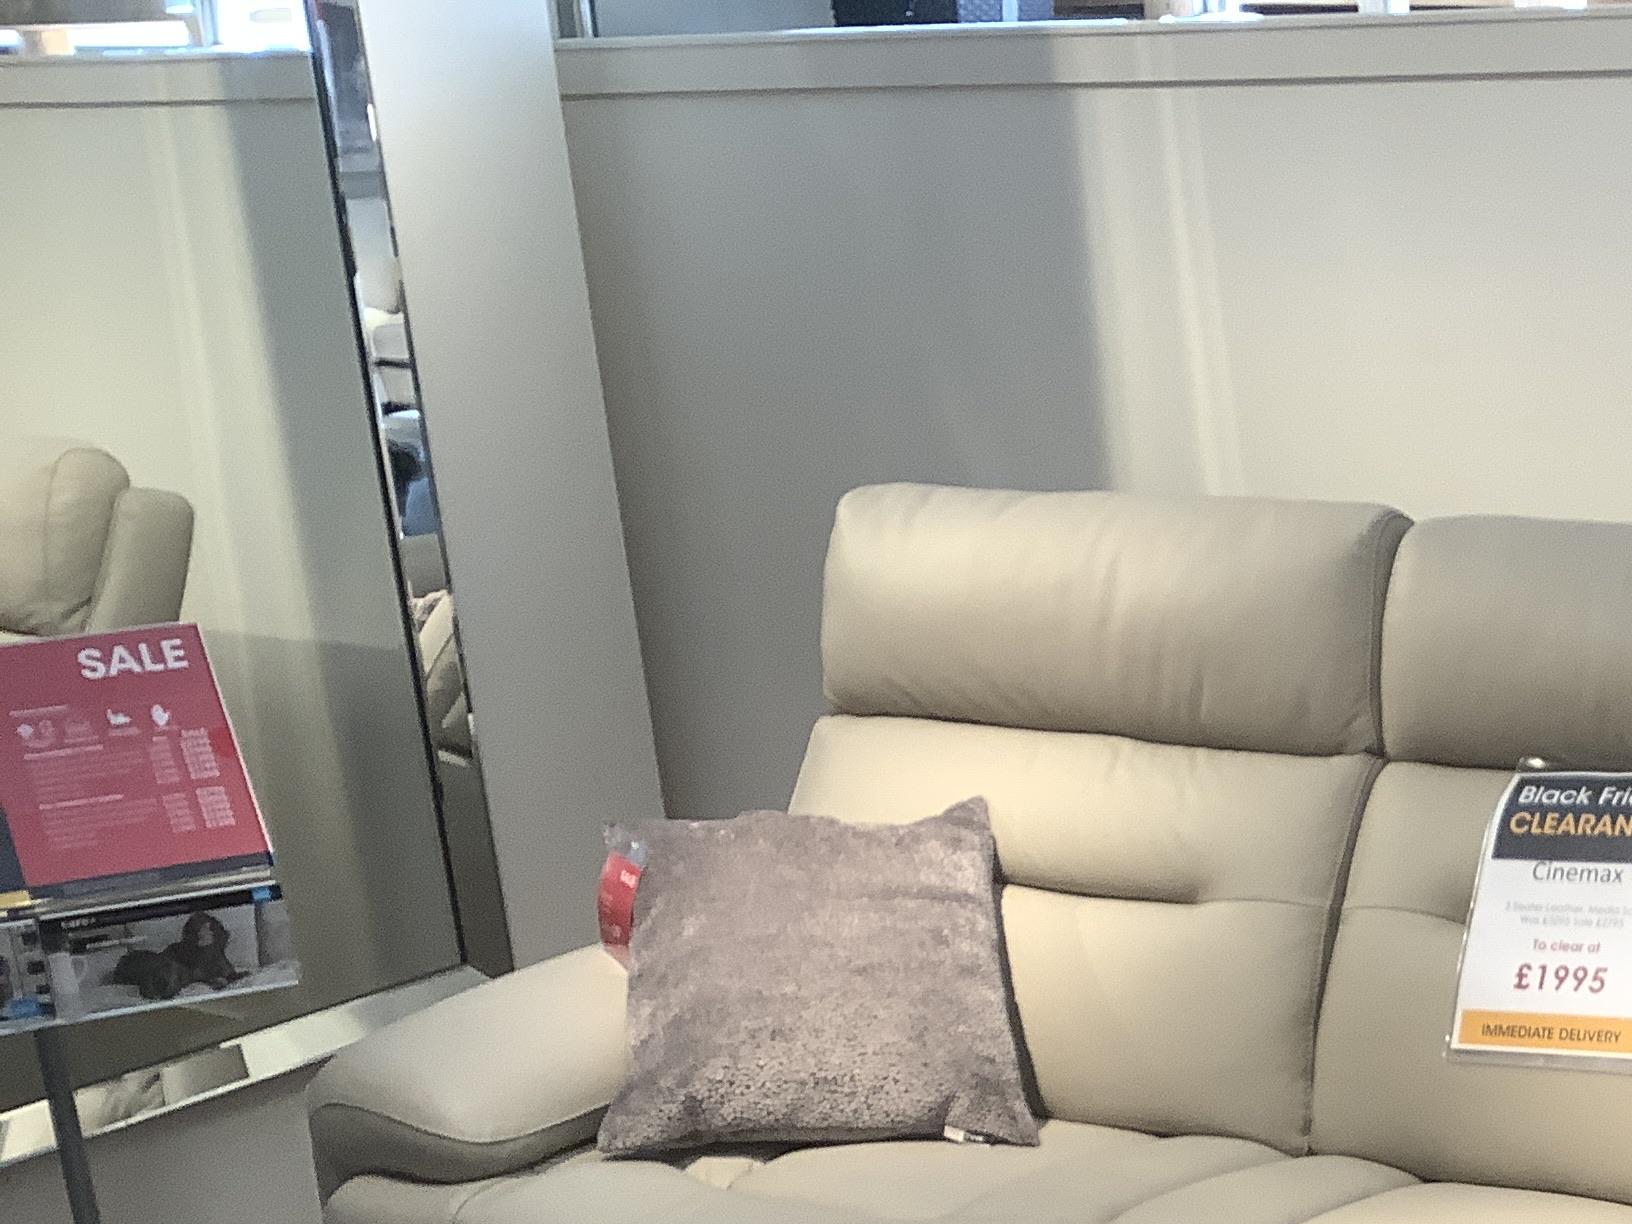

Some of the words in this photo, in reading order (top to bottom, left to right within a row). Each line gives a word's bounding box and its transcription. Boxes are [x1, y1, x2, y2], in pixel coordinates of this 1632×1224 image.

[77, 639, 189, 681] SALE
[1518, 786, 1591, 805] Black
[1532, 861, 1624, 884] Cinemax
[1533, 938, 1547, 951] To
[1550, 939, 1584, 953] clear
[1587, 941, 1601, 954] at
[1513, 963, 1608, 993] £1995
[1481, 1023, 1554, 1040] IMMEDIATE
[1558, 1026, 1622, 1043] DELIVERY
